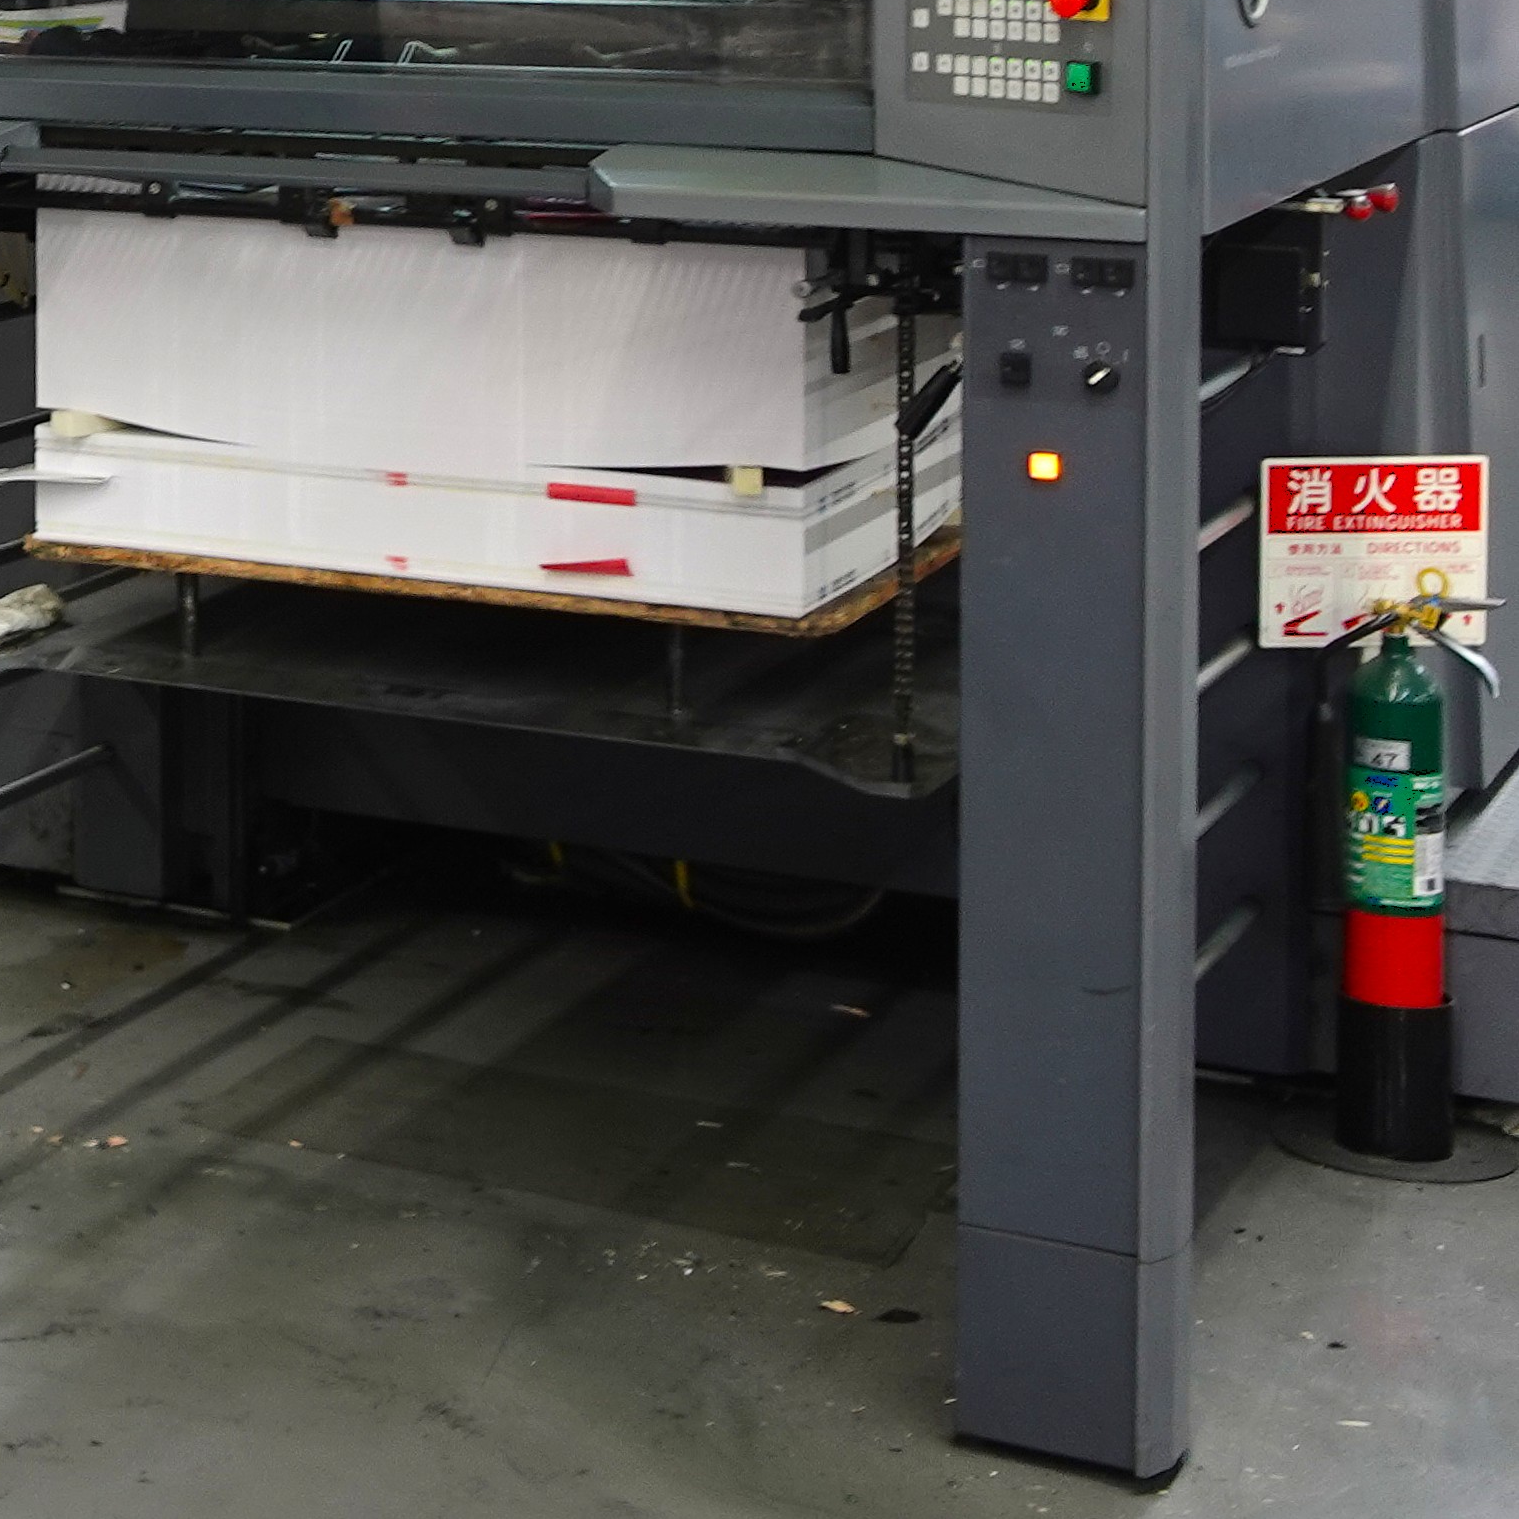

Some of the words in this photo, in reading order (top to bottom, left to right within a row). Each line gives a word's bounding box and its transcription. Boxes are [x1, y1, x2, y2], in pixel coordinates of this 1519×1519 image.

[1286, 467, 1463, 515] 消火器
[1285, 515, 1327, 531] FIRE
[1333, 514, 1463, 530] EXTINGUISHER
[1366, 541, 1461, 555] DIRECTIONS
